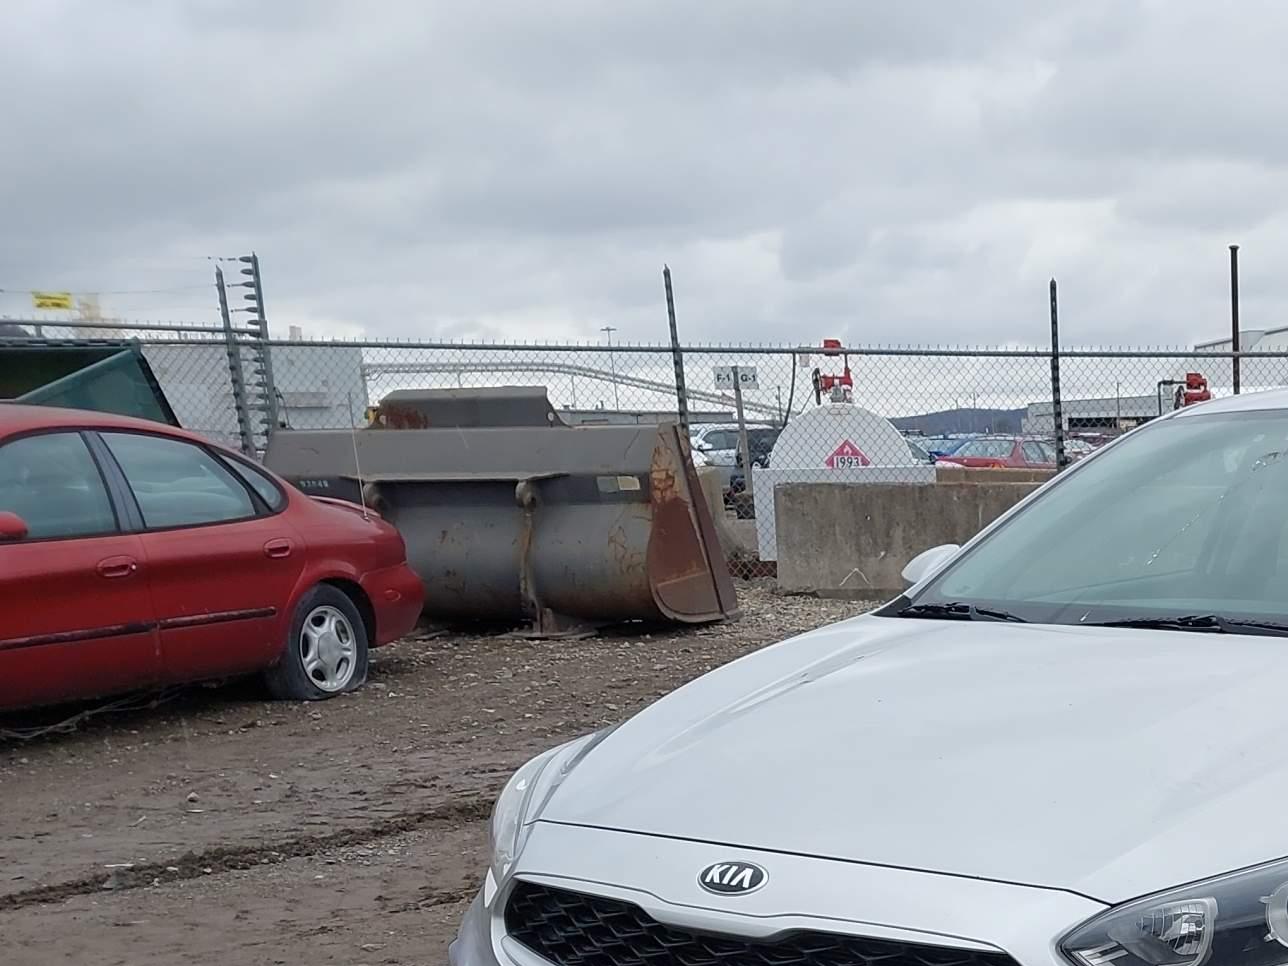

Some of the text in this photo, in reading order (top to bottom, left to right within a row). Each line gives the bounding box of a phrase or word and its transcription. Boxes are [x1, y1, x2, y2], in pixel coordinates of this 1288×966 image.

[716, 373, 730, 382] F-1
[740, 373, 756, 382] G-1
[836, 456, 860, 468] 1993
[704, 864, 754, 888] KIA
